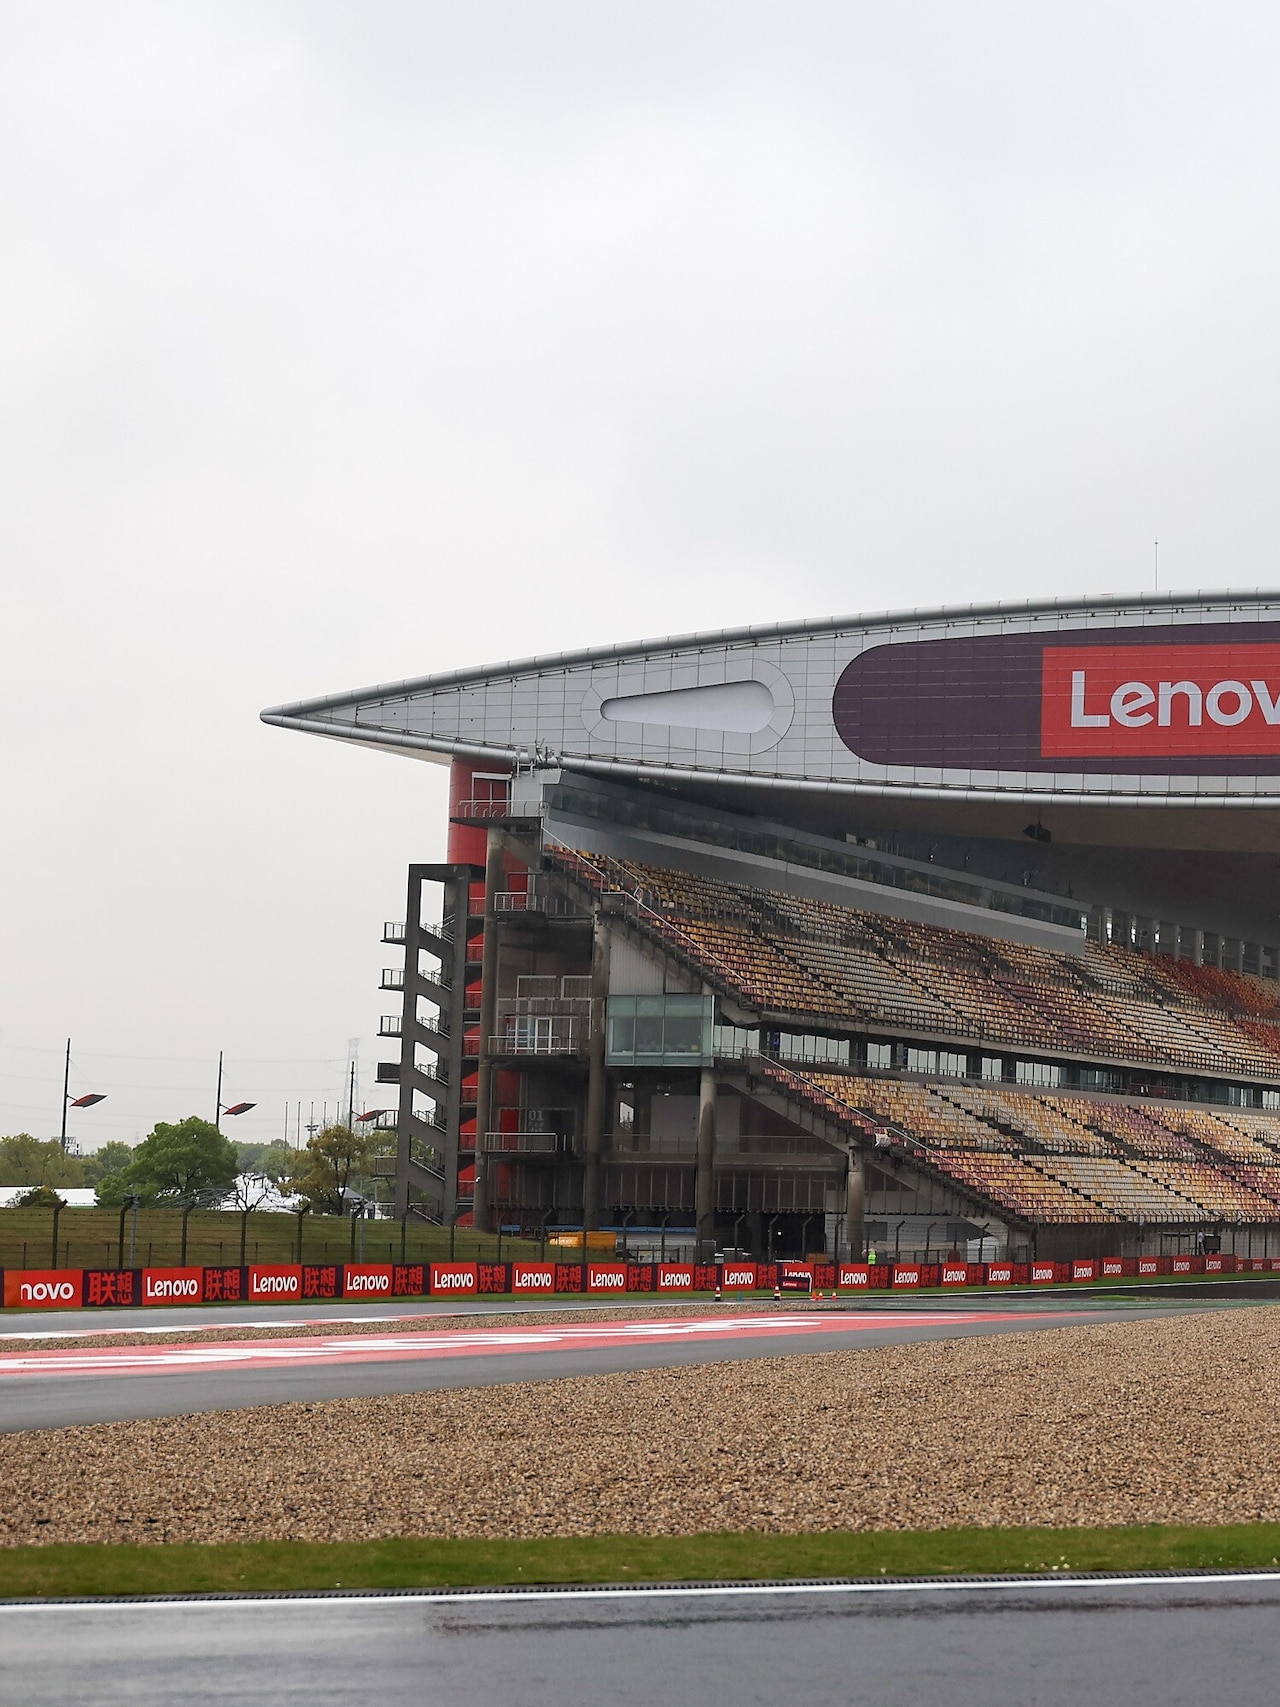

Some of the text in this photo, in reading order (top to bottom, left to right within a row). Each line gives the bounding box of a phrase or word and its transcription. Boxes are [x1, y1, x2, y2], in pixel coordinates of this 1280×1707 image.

[205, 1269, 241, 1301] 联想
[254, 1273, 297, 1292] Lenovo
[304, 1267, 336, 1297] 联想
[347, 1272, 388, 1290] Lenovo
[395, 1266, 423, 1295] 联想
[435, 1271, 473, 1288] Lenovo
[479, 1264, 506, 1293] 联想
[516, 1270, 551, 1286] Lenovo
[591, 1270, 624, 1286] Lenovo
[661, 1270, 690, 1286] Lenovo
[725, 1270, 753, 1284] Lenovo
[841, 1270, 867, 1284] Lenovo
[895, 1270, 918, 1283] Lenovo
[88, 1272, 133, 1305] 联想
[147, 1277, 197, 1296] Lenovo
